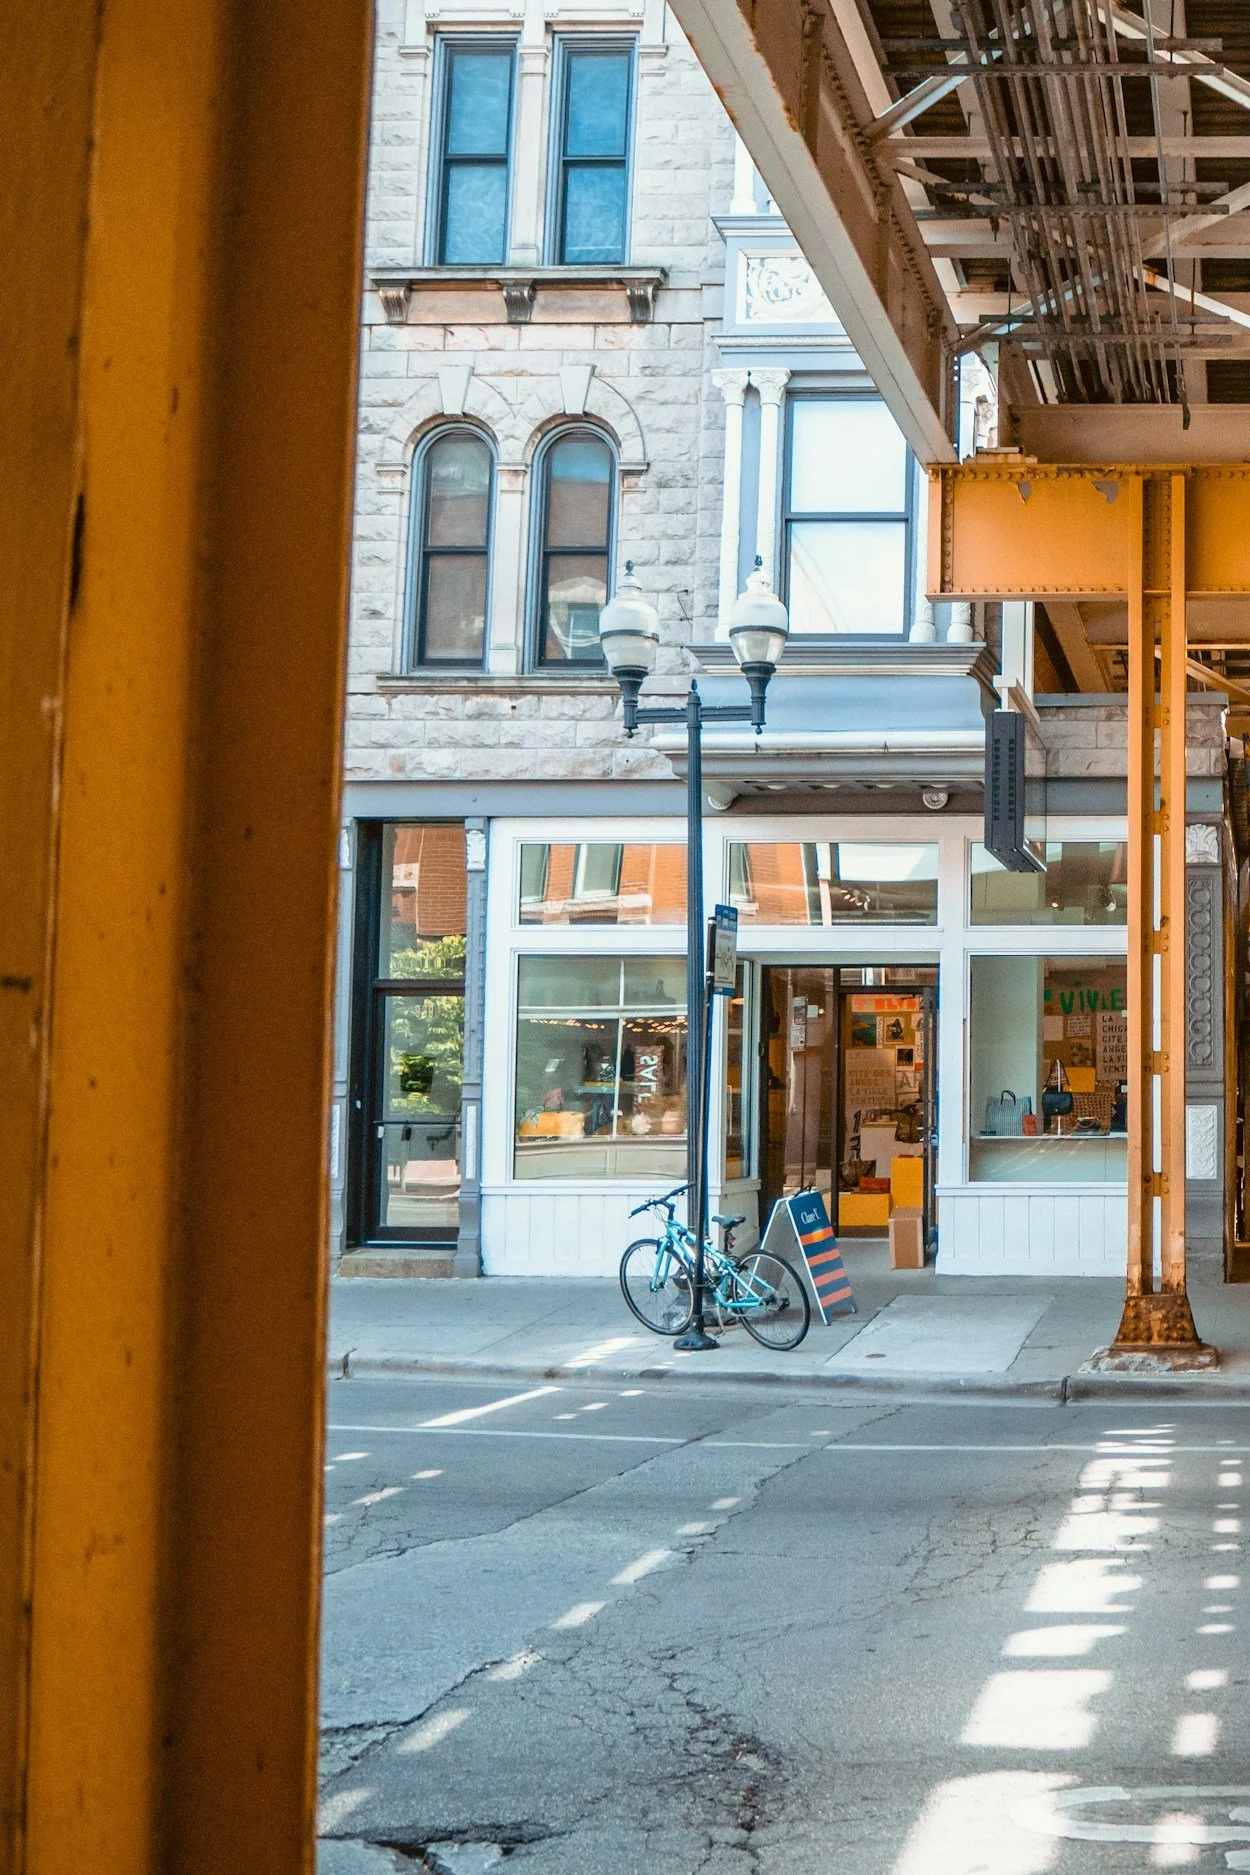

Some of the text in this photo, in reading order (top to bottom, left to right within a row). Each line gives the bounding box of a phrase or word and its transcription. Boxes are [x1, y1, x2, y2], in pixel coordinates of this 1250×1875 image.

[1102, 1015, 1114, 1023] LA
[1102, 1035, 1122, 1043] CITE
[1103, 1055, 1114, 1063] LA
[1103, 1065, 1127, 1073] VENT
